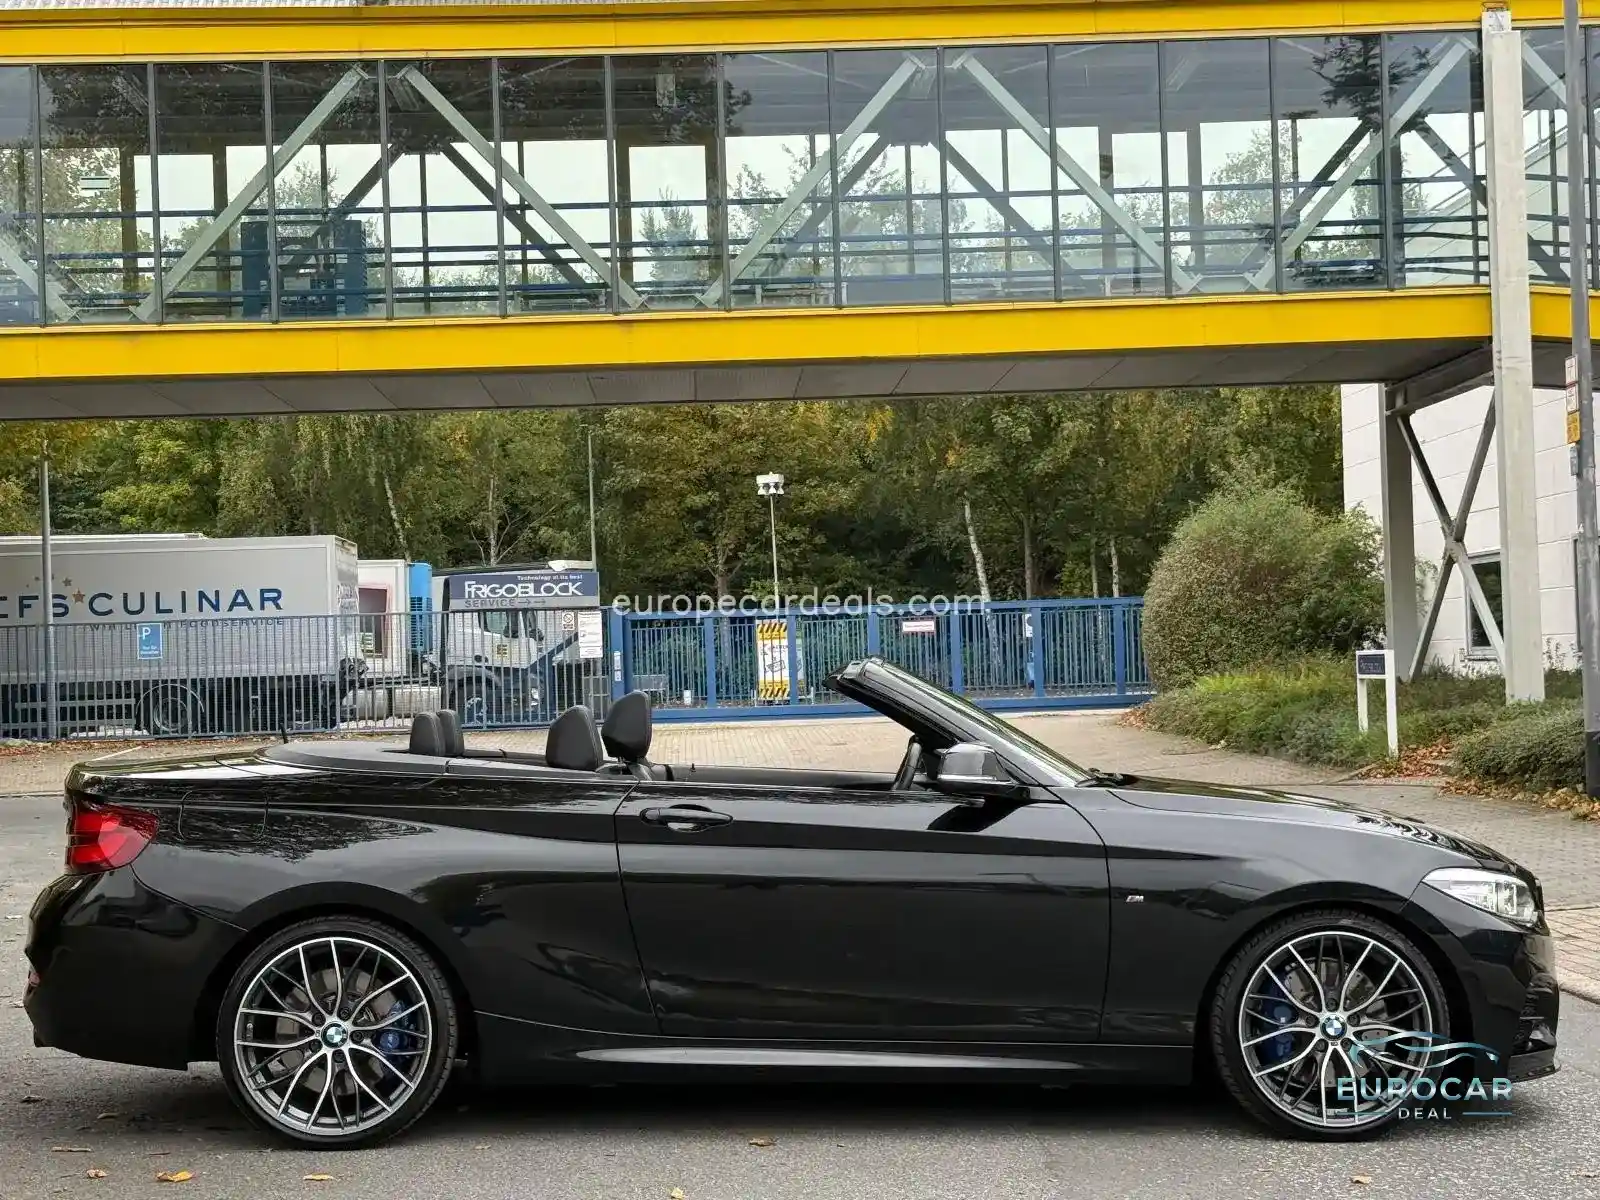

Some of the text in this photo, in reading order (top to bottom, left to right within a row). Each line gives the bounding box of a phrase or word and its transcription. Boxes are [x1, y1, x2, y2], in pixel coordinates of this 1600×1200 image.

[464, 581, 584, 599] FRIGOBLOCK
[88, 588, 283, 617] CULINAR
[464, 599, 516, 608] SERVICE
[142, 626, 151, 640] P
